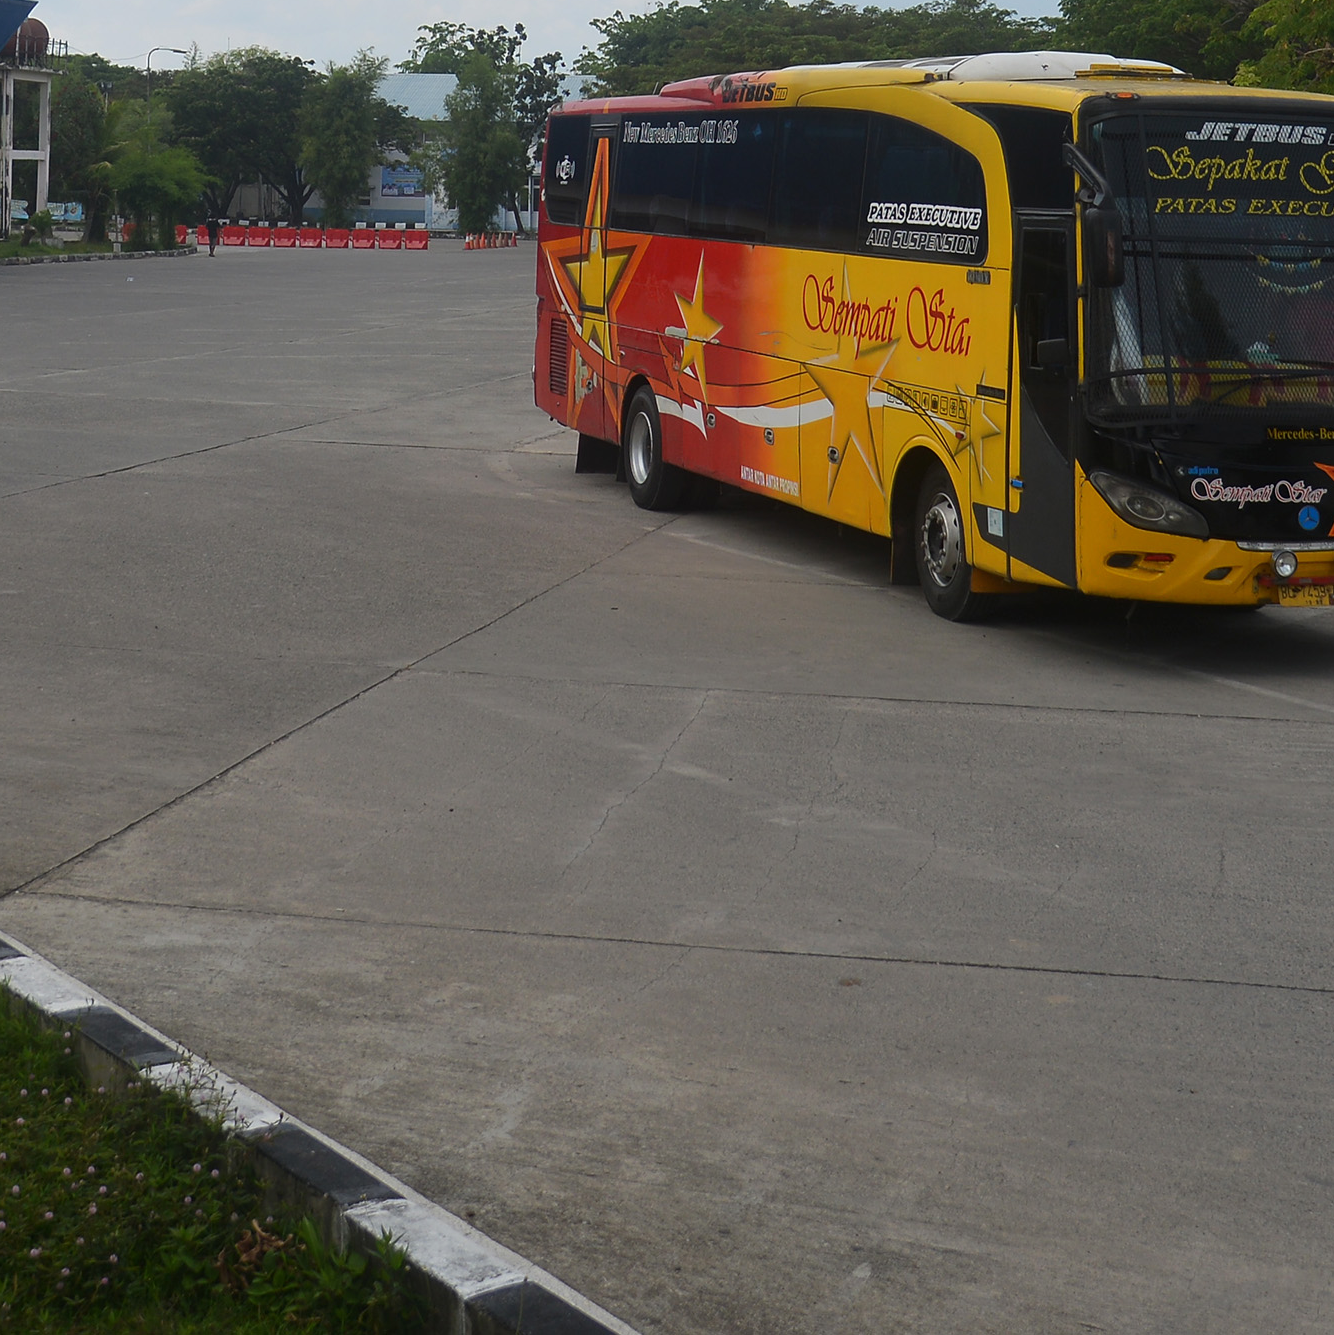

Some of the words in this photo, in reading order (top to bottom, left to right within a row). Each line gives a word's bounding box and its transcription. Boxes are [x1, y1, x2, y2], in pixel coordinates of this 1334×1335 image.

[623, 121, 640, 143] New
[640, 122, 677, 144] Mercedes
[677, 121, 699, 143] Benz
[699, 120, 716, 143] OH
[716, 120, 739, 144] 1626
[1185, 122, 1327, 145] JETBUS
[1146, 145, 1290, 191] Sepakat
[867, 203, 906, 224] PATAS
[907, 203, 982, 230] EXECUTIVE
[1154, 197, 1237, 214] PATAS
[866, 228, 891, 247] AIR
[892, 230, 979, 255] SUSPENSION
[803, 274, 899, 360] Sempati
[1190, 477, 1274, 509] Sempati
[1275, 480, 1328, 503] Star
